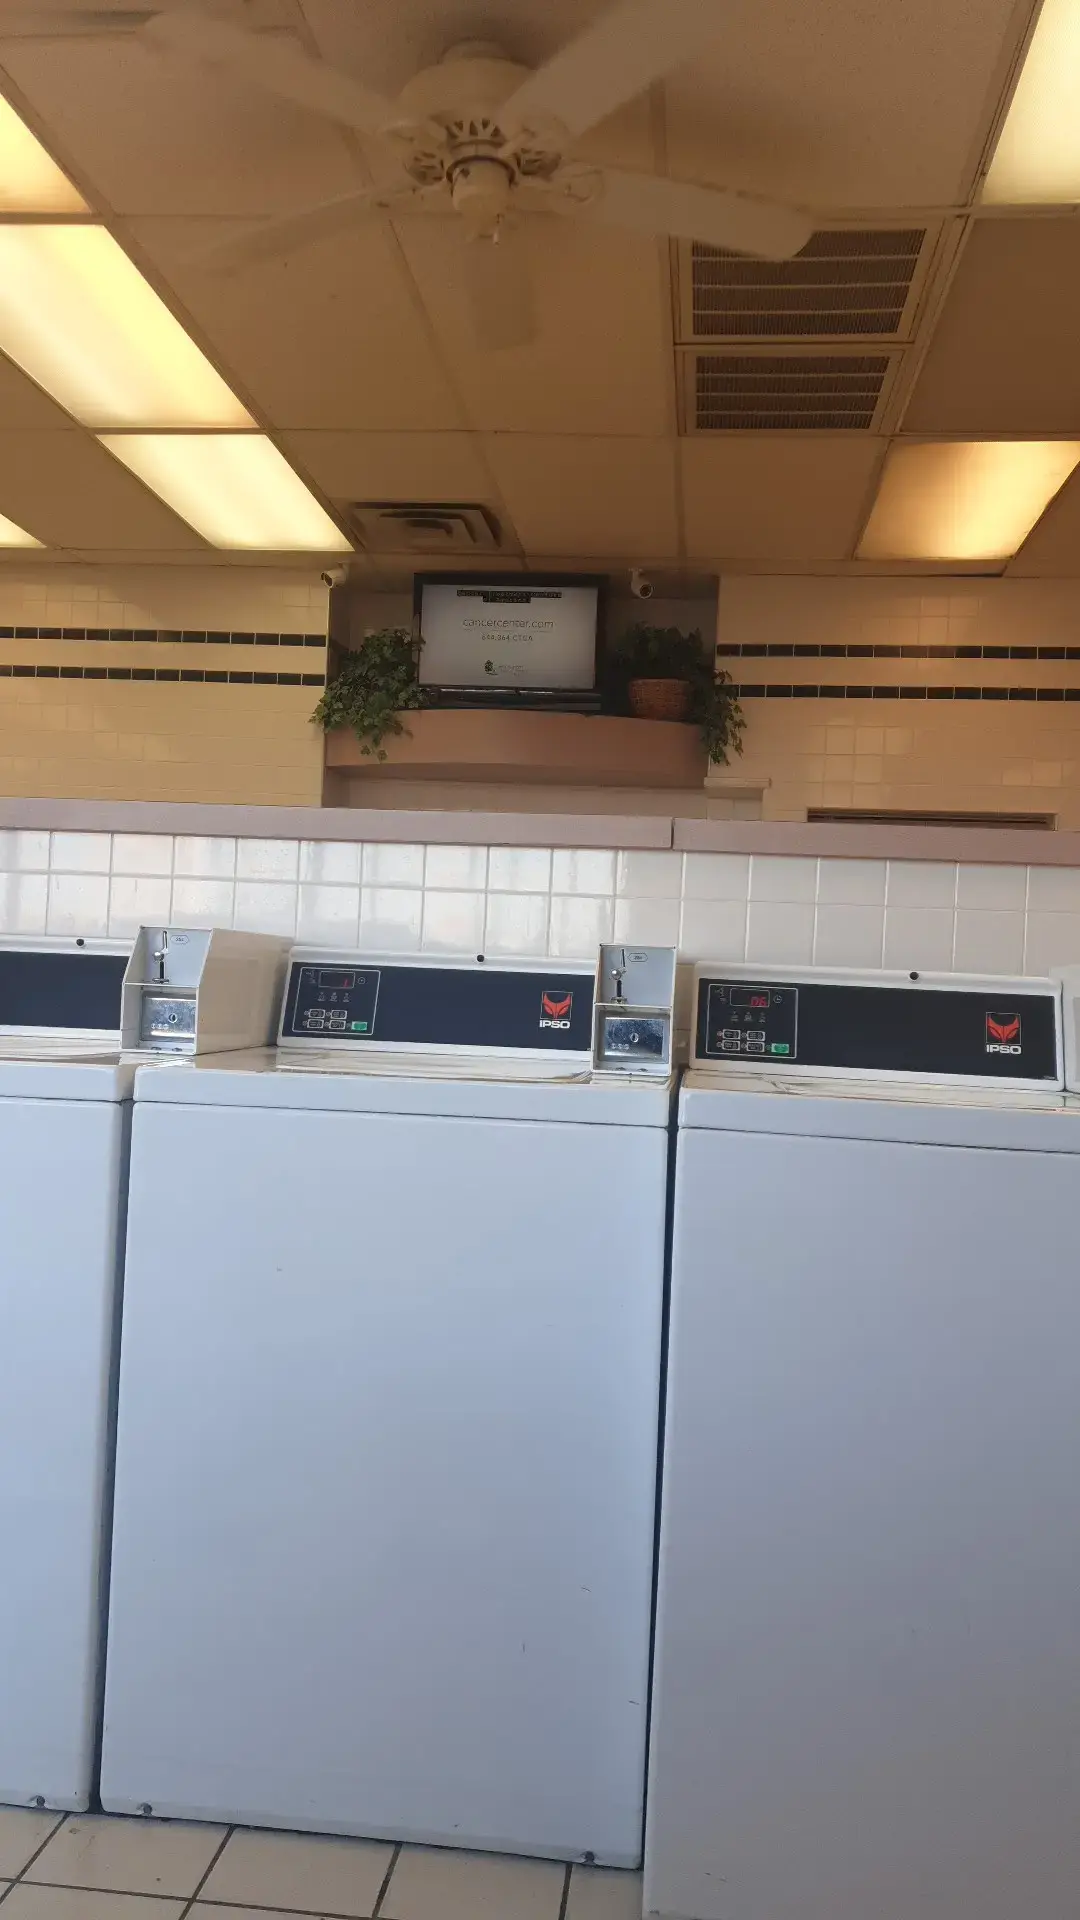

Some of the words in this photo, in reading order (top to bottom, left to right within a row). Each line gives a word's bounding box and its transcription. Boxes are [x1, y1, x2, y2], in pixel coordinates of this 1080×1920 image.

[462, 619, 554, 628] cancercenter.com
[539, 1020, 571, 1029] IPSO
[986, 1044, 1022, 1055] IPSO
